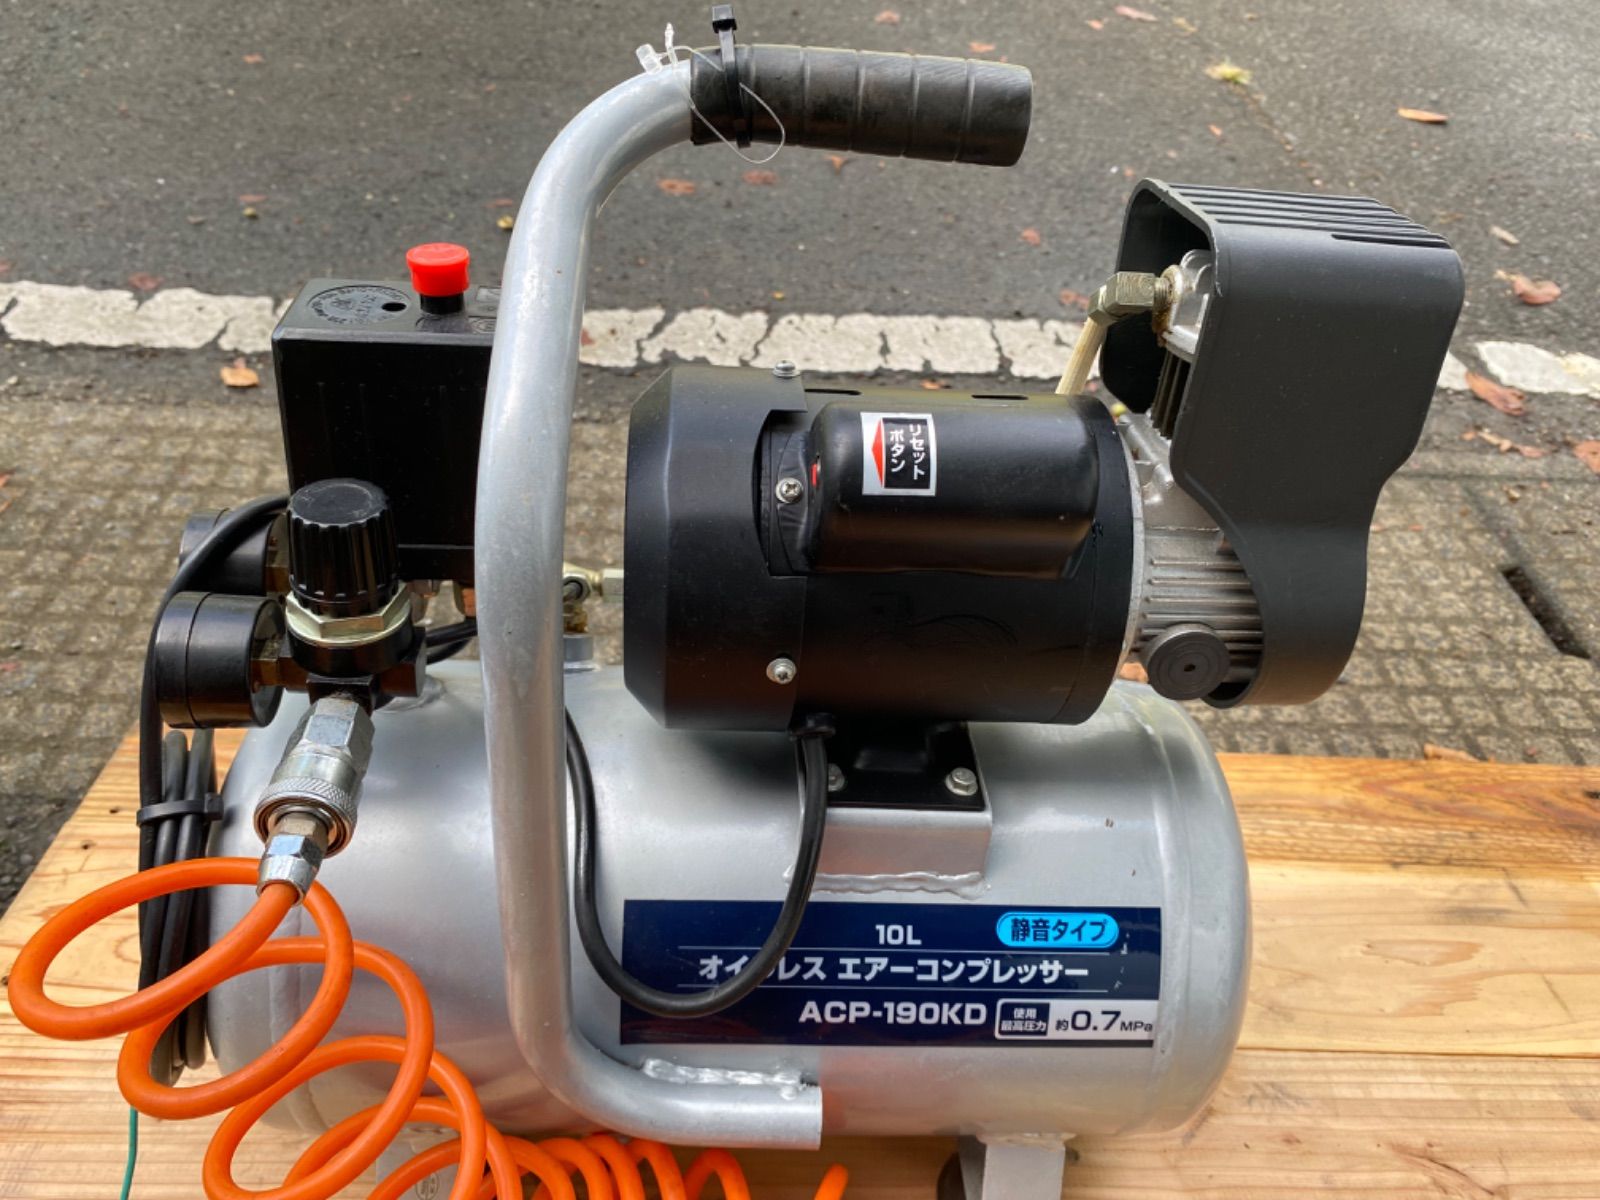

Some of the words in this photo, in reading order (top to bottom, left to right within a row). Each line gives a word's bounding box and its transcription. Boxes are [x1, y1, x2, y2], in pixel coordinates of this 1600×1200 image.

[889, 429, 905, 472] ボタン
[909, 424, 925, 480] リセット
[875, 924, 922, 945] 10L
[1010, 917, 1107, 943] 静音タイプ
[699, 954, 827, 981] オイレス
[838, 957, 1089, 984] エアーコンプレッサー
[799, 1001, 987, 1025] ACP-190KD
[1013, 1007, 1037, 1019] 使用
